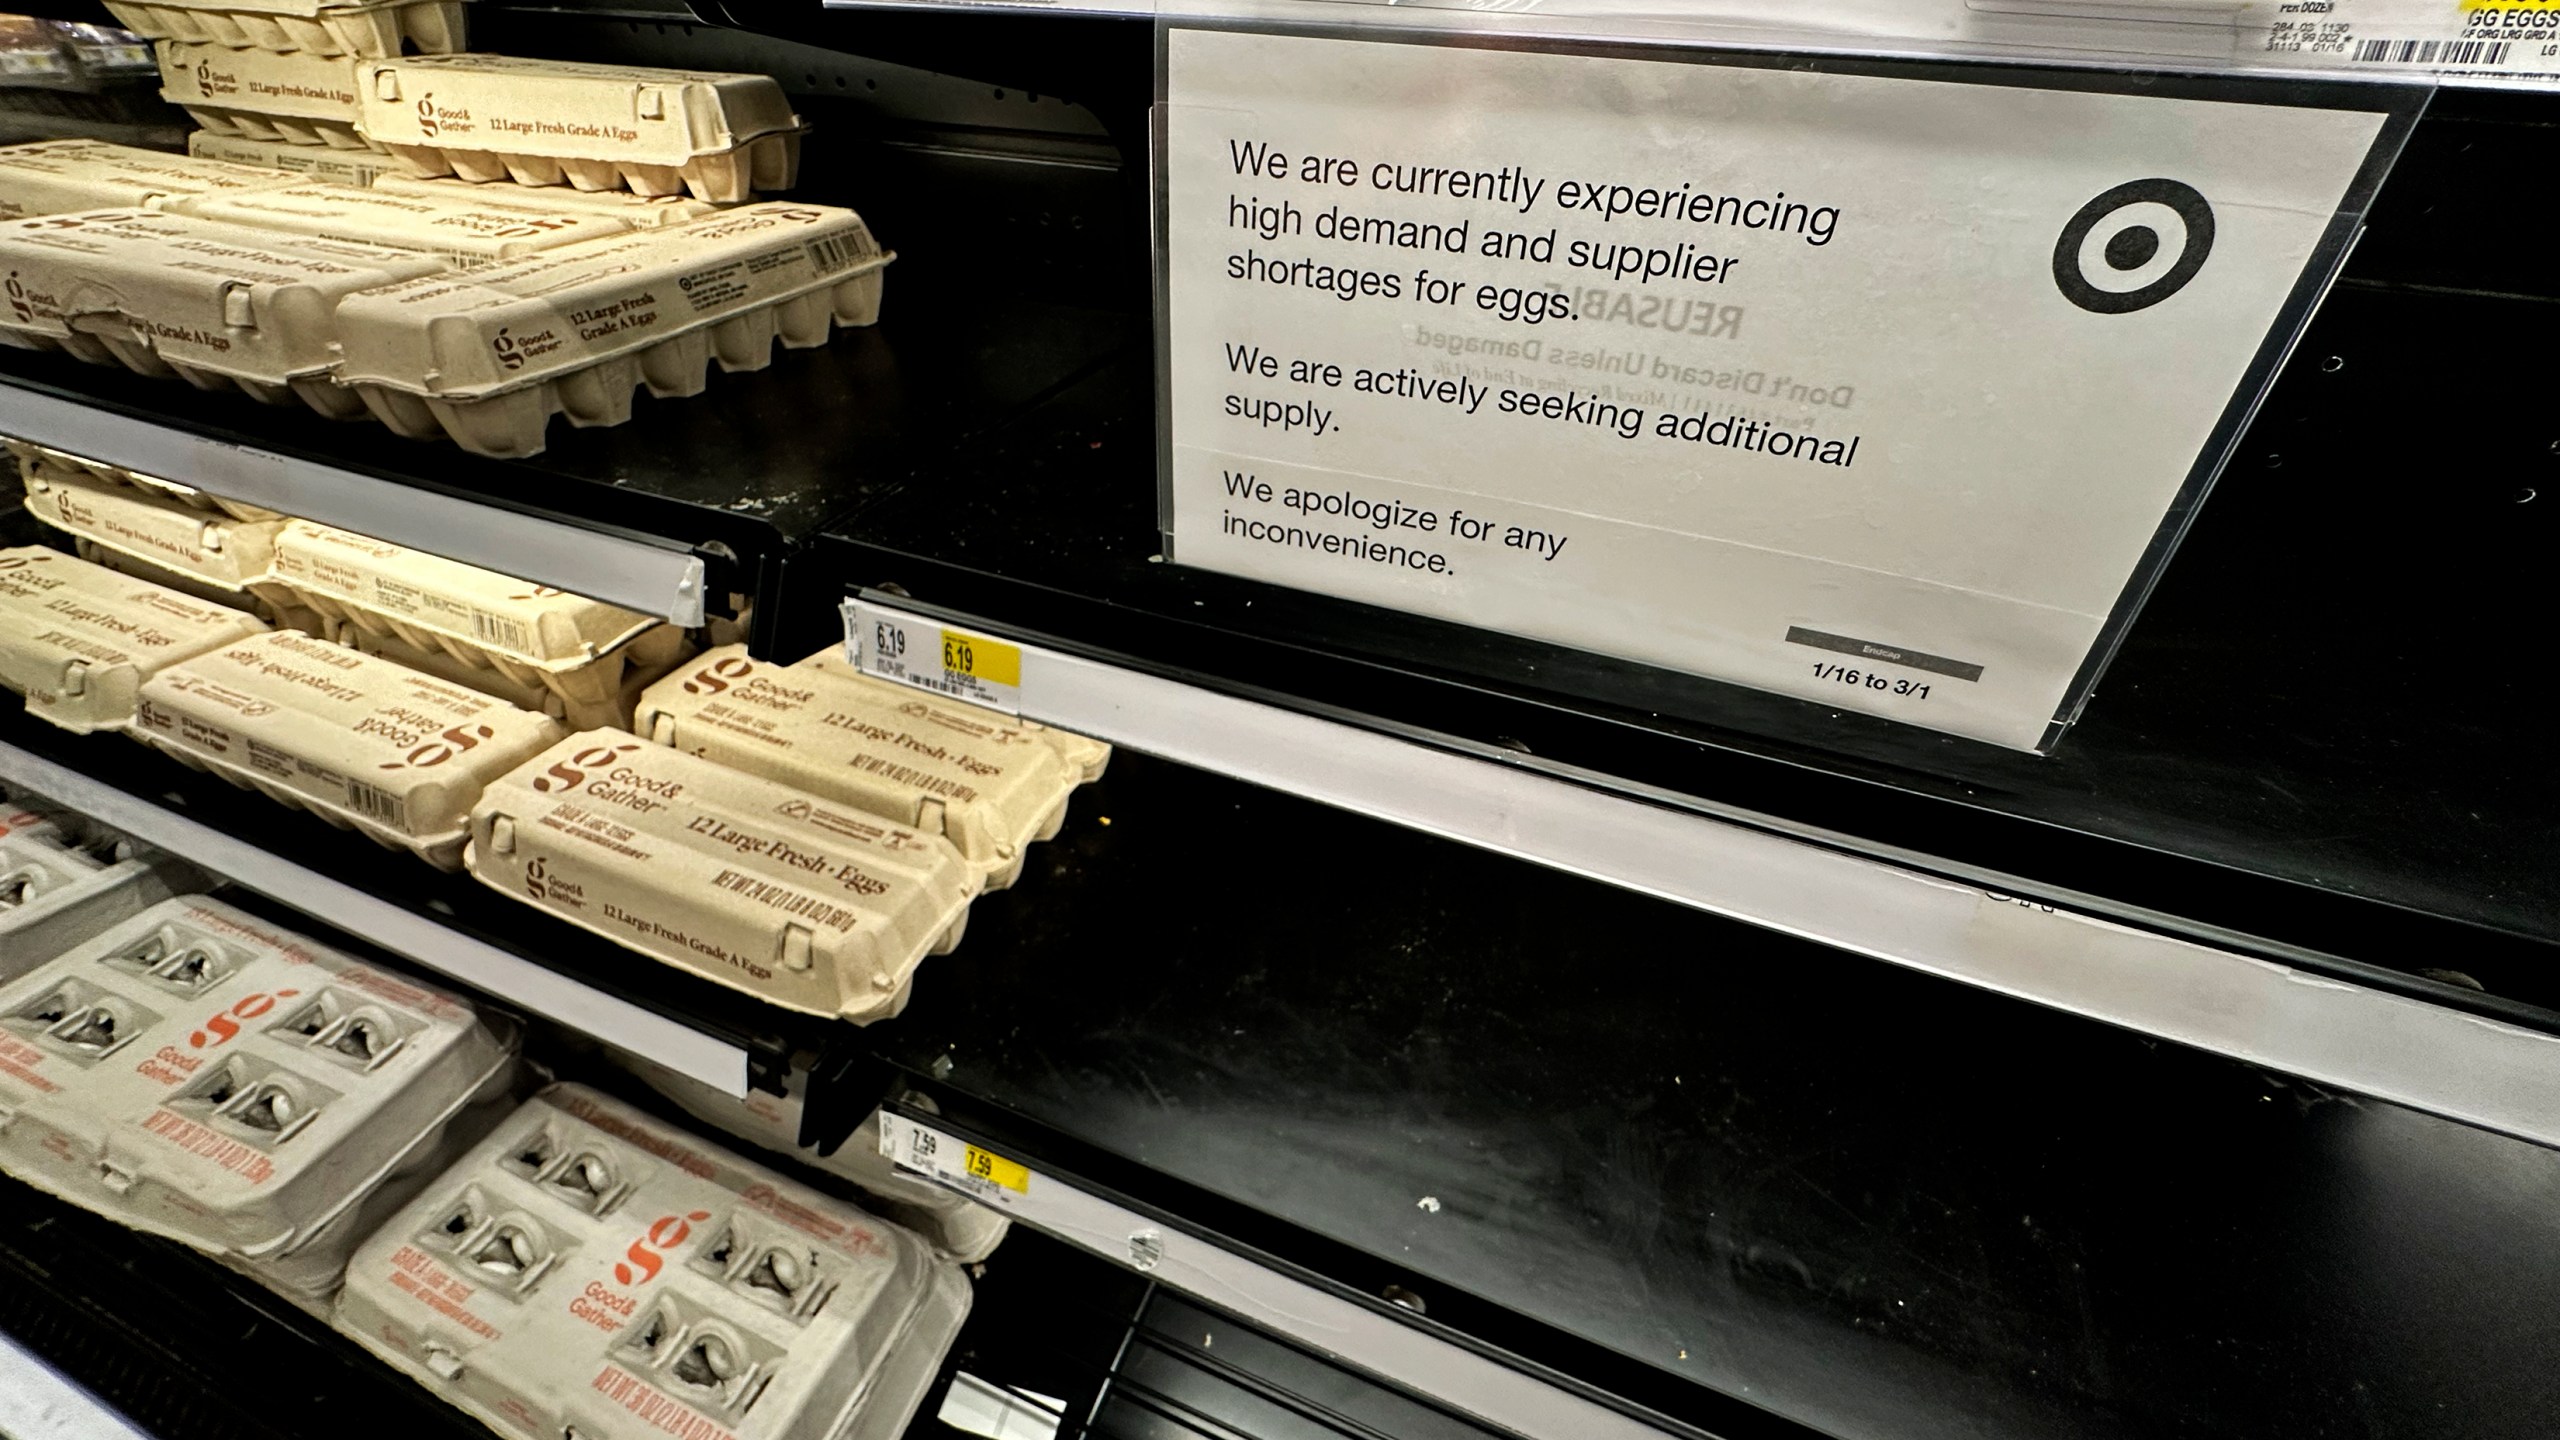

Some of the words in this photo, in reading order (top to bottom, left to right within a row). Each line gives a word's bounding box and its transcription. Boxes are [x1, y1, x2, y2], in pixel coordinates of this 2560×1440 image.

[2322, 23, 2350, 33] 1130
[2477, 29, 2499, 39] ORG
[2501, 29, 2523, 40] LRG
[2524, 30, 2547, 40] GRD
[2547, 30, 2556, 40] A
[2502, 8, 2560, 28] EGGS
[2312, 43, 2344, 52] 01/16
[259, 83, 280, 97] Large
[281, 84, 303, 96] Fresh
[490, 118, 502, 131] 12
[502, 119, 534, 135] Large
[536, 121, 565, 135] Fresh
[567, 123, 599, 138] Grade
[602, 126, 610, 138] A
[612, 127, 638, 142] Eggs
[1230, 139, 1288, 179] We
[1300, 156, 1358, 187] are
[1372, 163, 1545, 212] currently
[1557, 181, 1841, 247] experiencing
[1229, 194, 1302, 241] high
[1315, 205, 1469, 254] demand
[1480, 228, 1557, 263] and
[1567, 240, 1739, 284] supplier
[1227, 248, 1401, 302] shortages
[1414, 269, 1466, 306] for
[1476, 285, 1579, 325] eggs.
[570, 312, 585, 327] 12
[584, 302, 622, 323] Large
[623, 291, 656, 313] Fresh
[157, 323, 192, 342] Grade
[194, 330, 203, 344] A
[203, 331, 231, 353] Eggs
[581, 322, 618, 343] Grade
[618, 320, 630, 334] A
[630, 310, 657, 331] Eggs
[1225, 342, 1278, 378] We
[1290, 360, 1342, 387] are
[1354, 368, 1489, 415] actively
[1498, 389, 1644, 439] seeking
[1655, 411, 1860, 467] additional
[1225, 395, 1340, 436] supply.
[1223, 470, 1273, 503] We
[1283, 488, 1438, 535] apologize
[1449, 510, 1496, 542] for
[1504, 527, 1568, 562] any
[1224, 510, 1456, 576] inconvenience.
[877, 624, 905, 655] 6.19
[1862, 644, 1901, 660] Endcap
[945, 641, 973, 673] 6.19
[1813, 662, 1860, 685] 1/16
[1866, 673, 1888, 691] to
[1894, 679, 1931, 700] 3/1
[731, 687, 795, 711] Gather
[822, 711, 845, 727] 12
[839, 713, 894, 743] Large
[893, 732, 947, 760] Fresh
[956, 754, 1004, 777] Eggs
[587, 780, 661, 813] Gather
[687, 815, 710, 833] 12
[708, 821, 768, 853] Large
[766, 839, 827, 873] Fresh
[833, 864, 890, 897] Eggs
[604, 904, 616, 918] 12
[617, 909, 651, 933] Large
[653, 924, 688, 946] Fresh
[689, 937, 728, 961] Grade
[730, 954, 739, 966] A
[741, 956, 772, 980] Eggs
[912, 1129, 936, 1154] 7.59
[967, 1150, 991, 1176] 7.59
[569, 1297, 618, 1333] Gather
